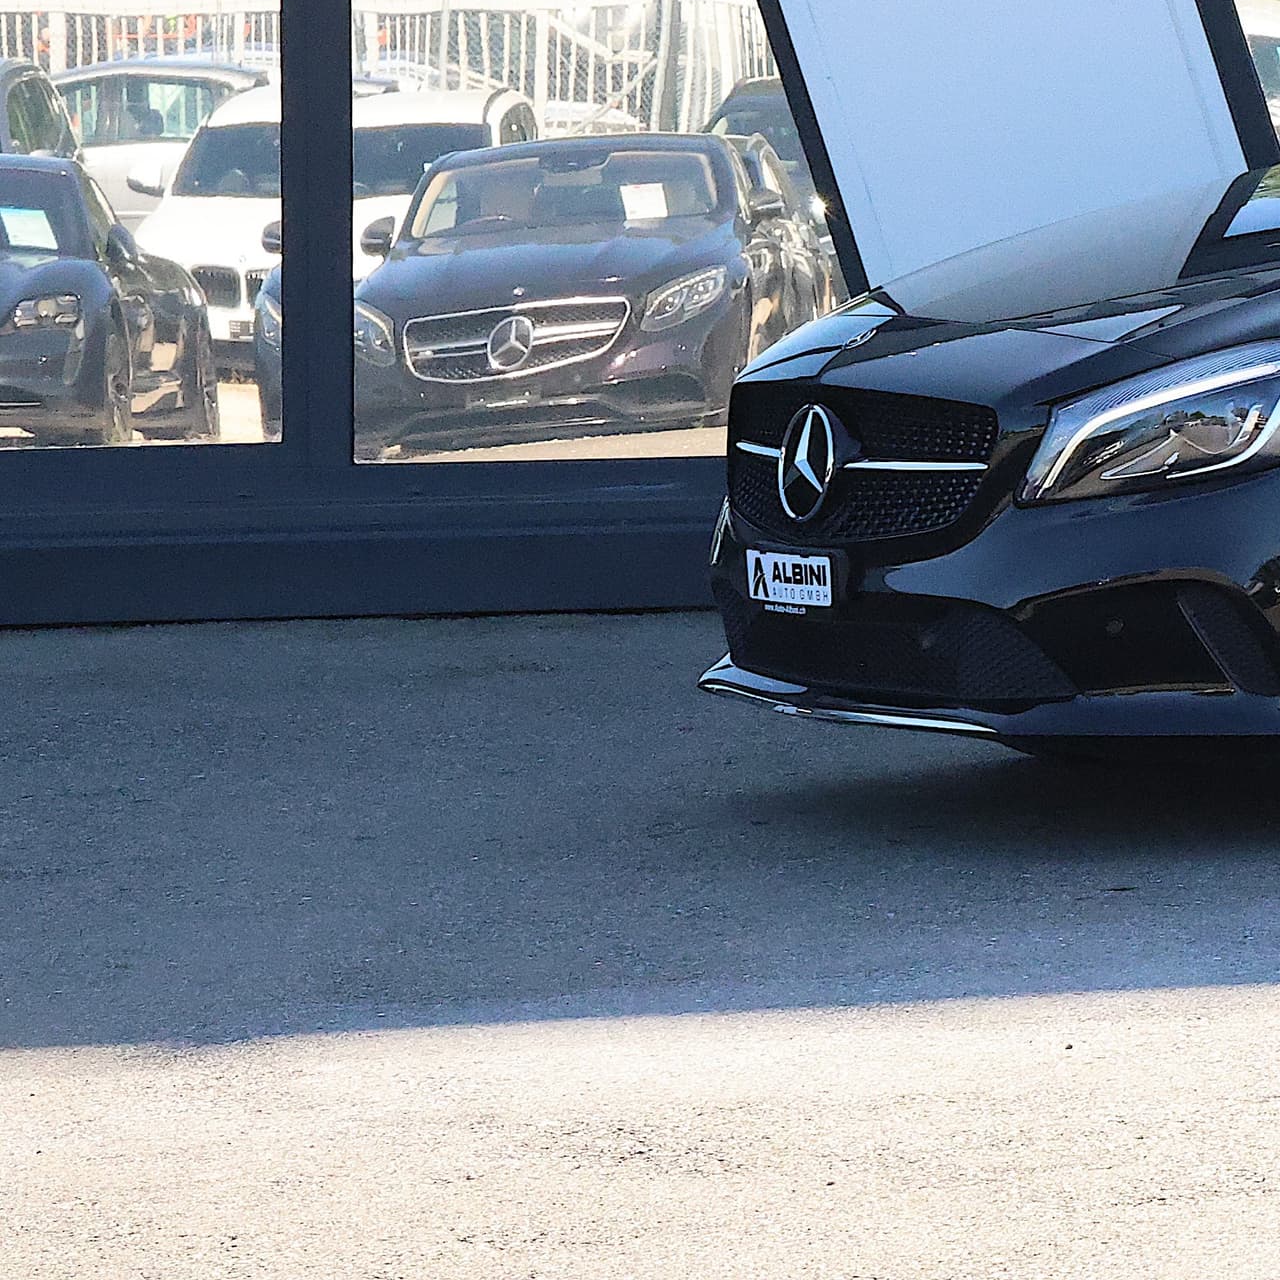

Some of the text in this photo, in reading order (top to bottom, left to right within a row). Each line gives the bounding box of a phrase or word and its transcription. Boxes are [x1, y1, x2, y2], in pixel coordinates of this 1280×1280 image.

[772, 561, 827, 586] ALBINI
[772, 586, 829, 601] AUTO GMBH
